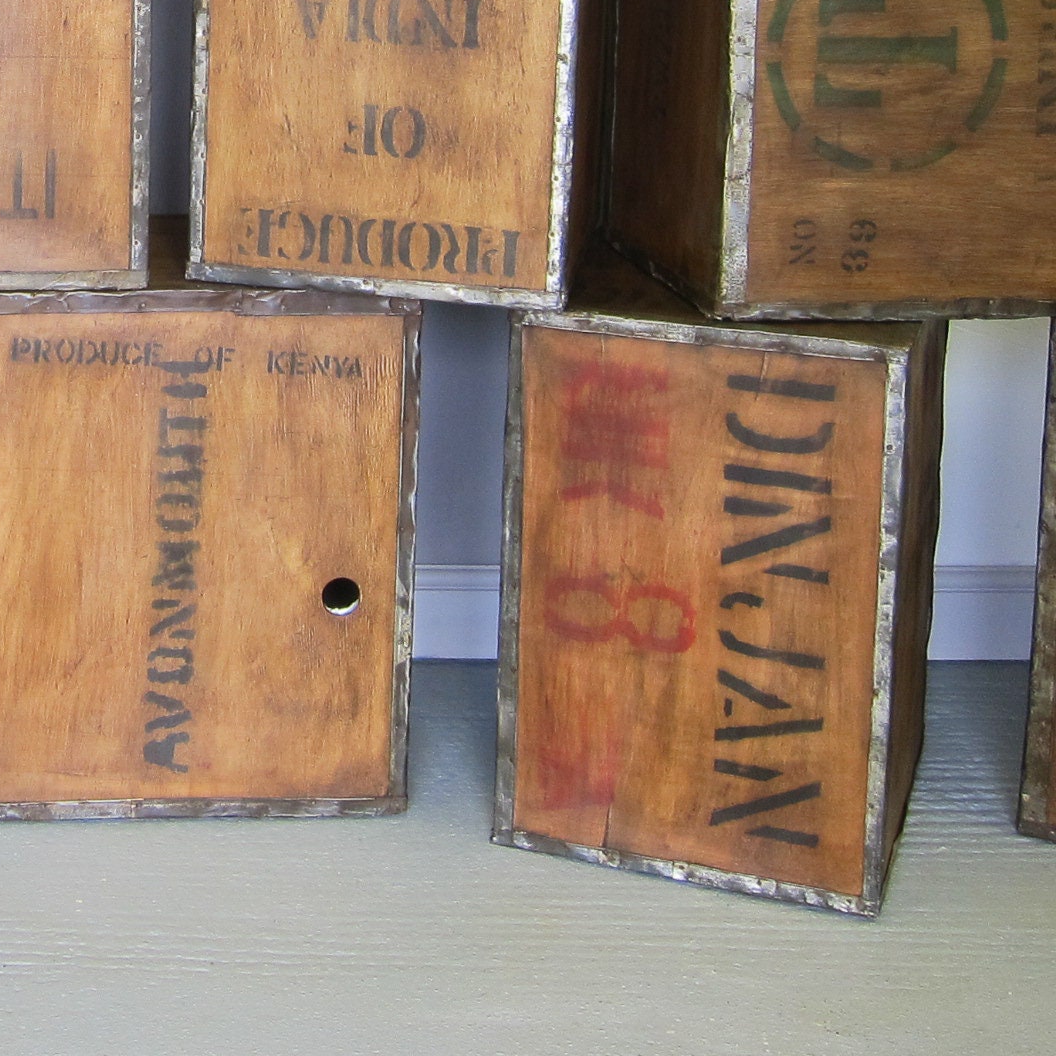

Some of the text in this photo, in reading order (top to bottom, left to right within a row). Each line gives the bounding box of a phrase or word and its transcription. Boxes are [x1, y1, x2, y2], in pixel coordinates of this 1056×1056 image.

[344, 103, 426, 159] OF
[238, 206, 521, 278] PRODUCE
[9, 337, 364, 380] PRODUCE OF KENYA
[144, 359, 209, 774] AVONMOUTH
